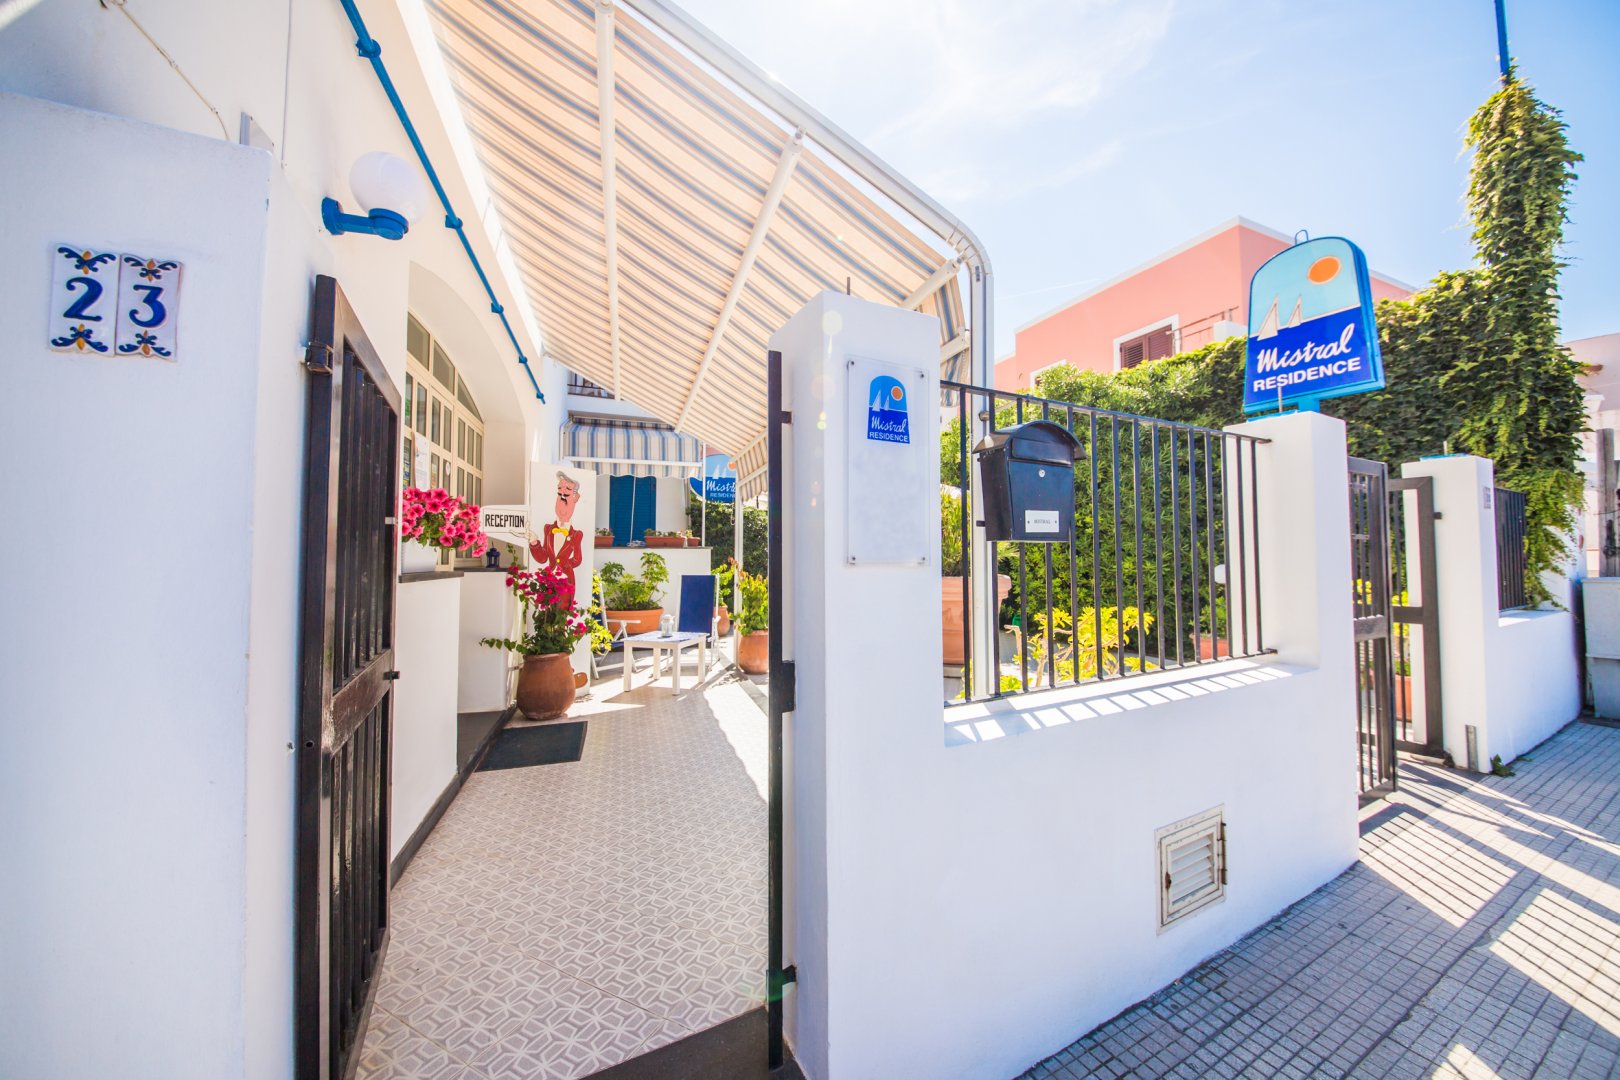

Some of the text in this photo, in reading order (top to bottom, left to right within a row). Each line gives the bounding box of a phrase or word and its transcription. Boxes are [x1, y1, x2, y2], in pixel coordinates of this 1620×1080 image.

[63, 276, 167, 328] 23
[1256, 322, 1355, 374] Mistral
[1253, 356, 1362, 392] RESIDENCE
[869, 431, 909, 443] RESIDENCE
[871, 415, 907, 433] Mistral
[484, 513, 525, 528] RECEPTION
